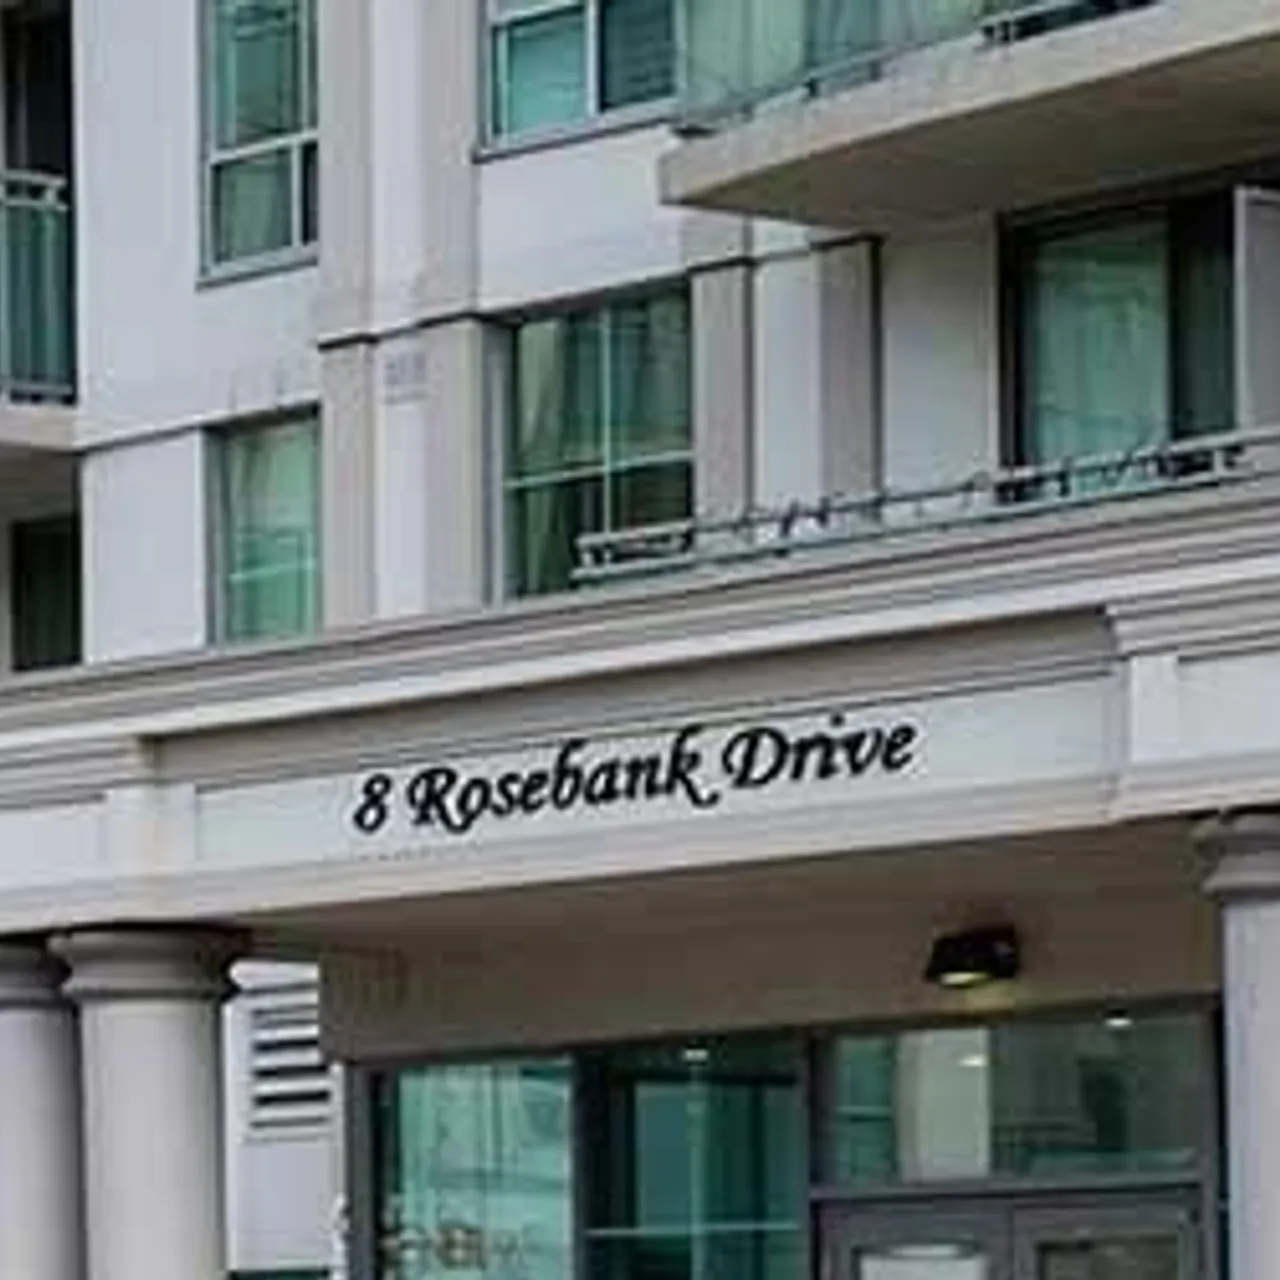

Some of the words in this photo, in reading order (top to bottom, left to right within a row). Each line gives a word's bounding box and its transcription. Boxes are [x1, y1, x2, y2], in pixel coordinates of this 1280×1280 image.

[353, 774, 391, 834] 8
[406, 724, 720, 834] Rosebank
[721, 713, 917, 788] Drive
